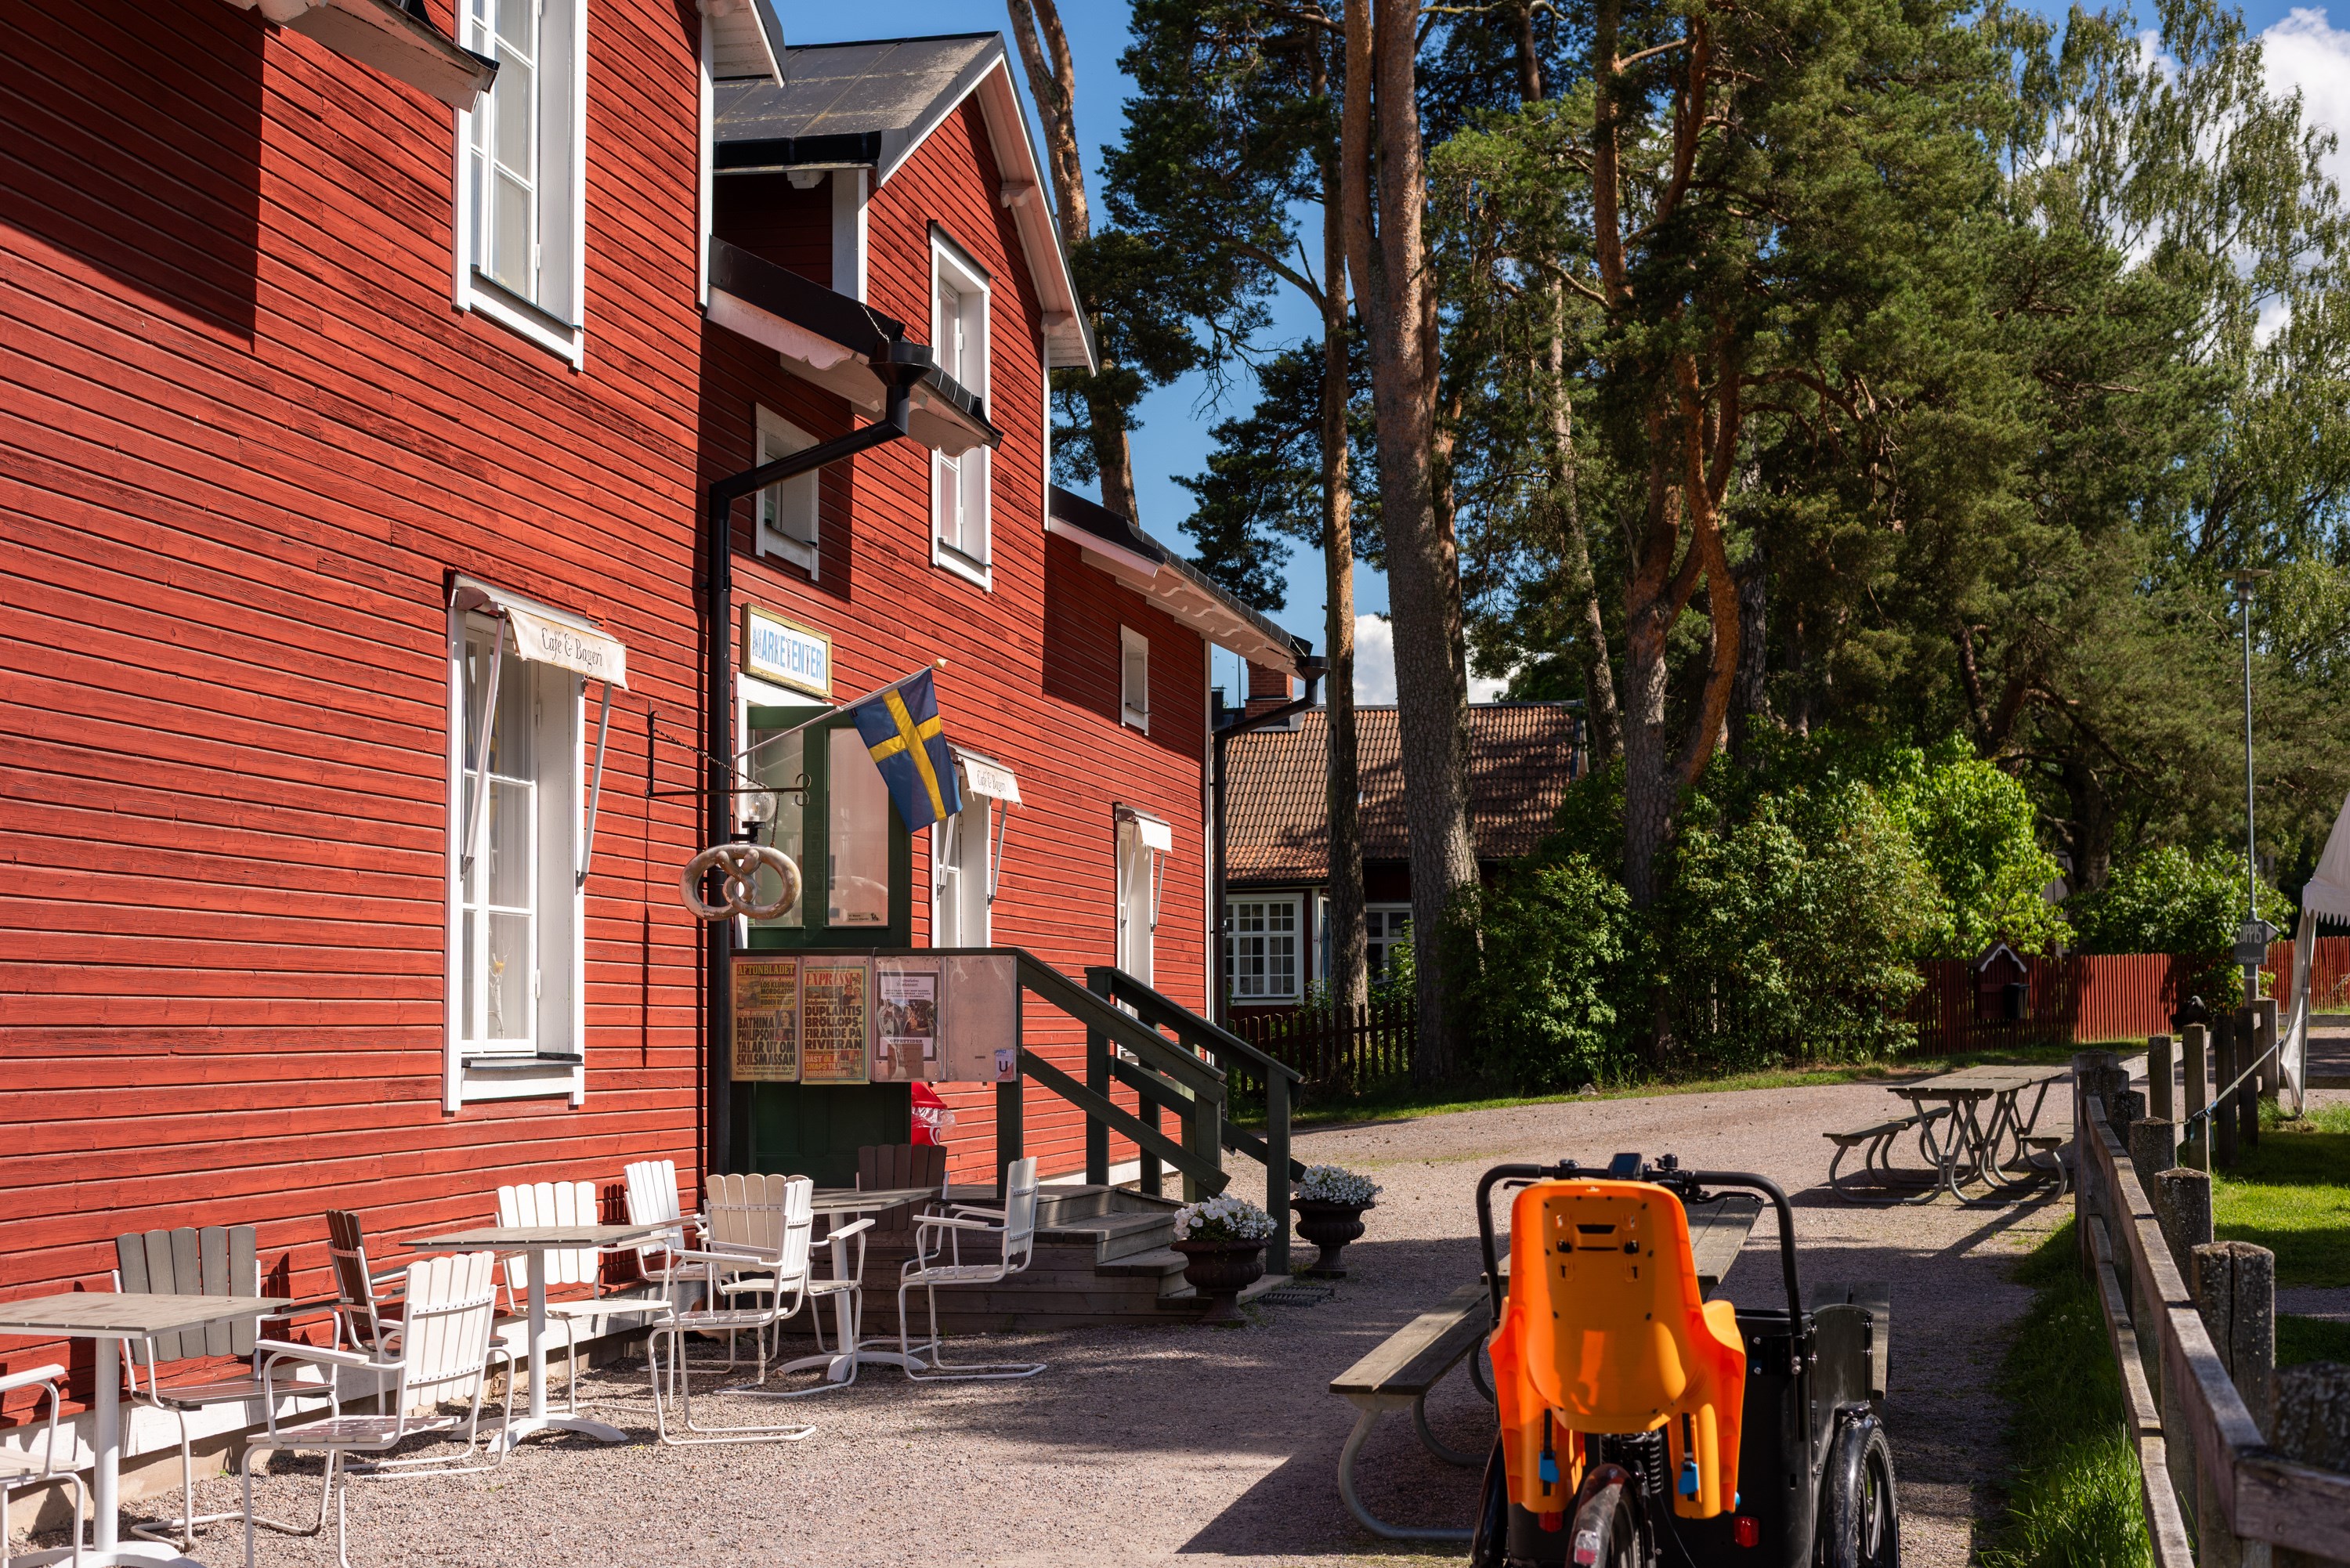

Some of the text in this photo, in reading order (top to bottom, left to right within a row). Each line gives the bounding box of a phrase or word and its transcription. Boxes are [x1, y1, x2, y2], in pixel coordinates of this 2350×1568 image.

[542, 628, 602, 672] Café & Bageri
[752, 627, 825, 681] MARKETENTERI
[738, 965, 794, 975] AFTONBLADET
[805, 1006, 862, 1016] DUPLANTIS
[737, 1017, 774, 1028] BATHINA
[805, 1017, 862, 1027] BRÖLLOPS-
[737, 1029, 774, 1041] PHILIPSON
[805, 1027, 862, 1038] FIRANDE PÅ
[737, 1042, 795, 1053] TALAR UT OM
[805, 1039, 862, 1050] RIVIERAN
